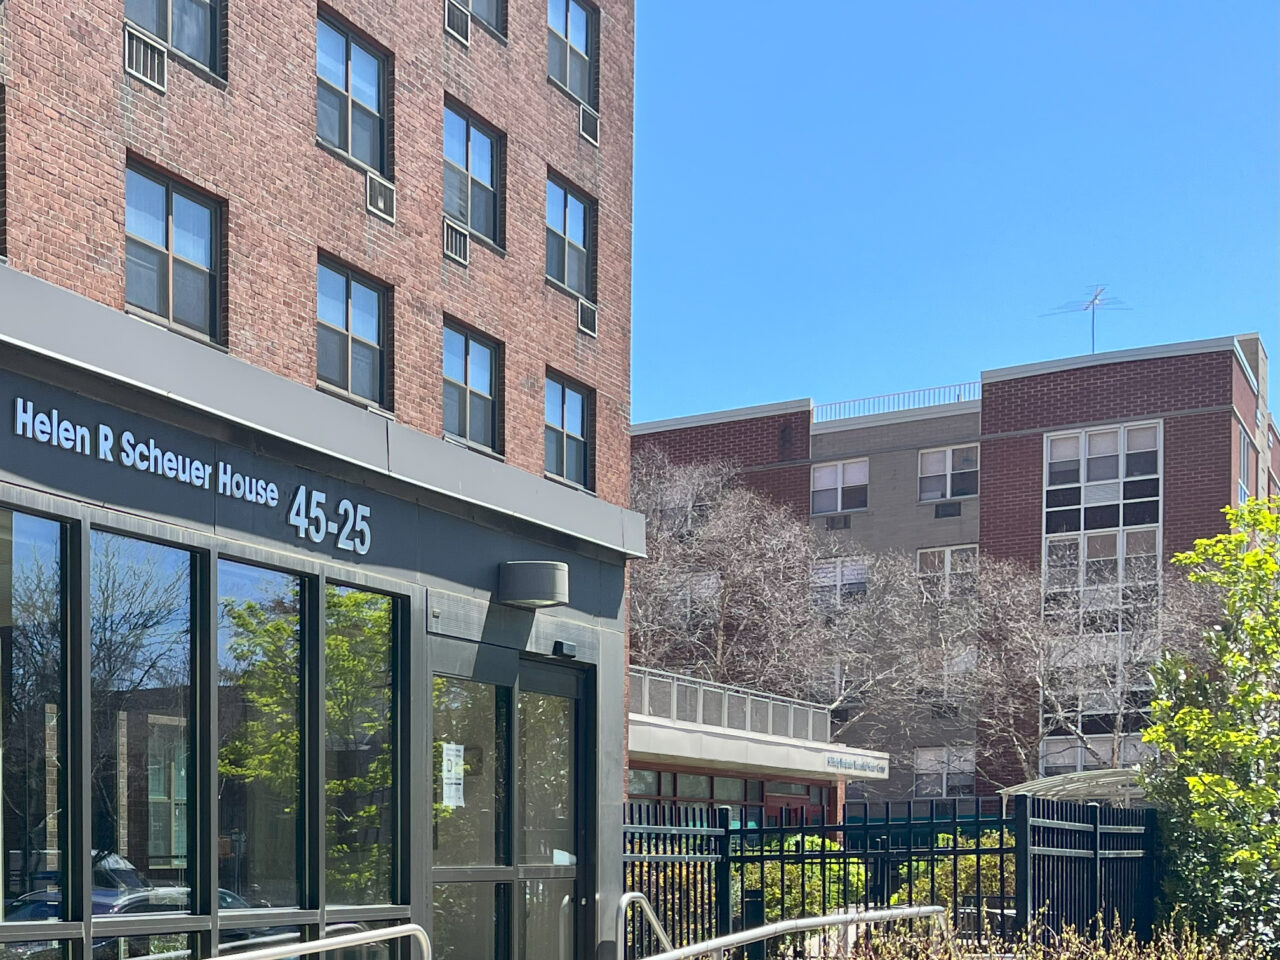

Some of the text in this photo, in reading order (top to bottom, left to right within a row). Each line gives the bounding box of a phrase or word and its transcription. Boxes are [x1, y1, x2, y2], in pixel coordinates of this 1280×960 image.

[14, 396, 279, 507] Helen R Scheuer House
[288, 484, 371, 555] 45-25
